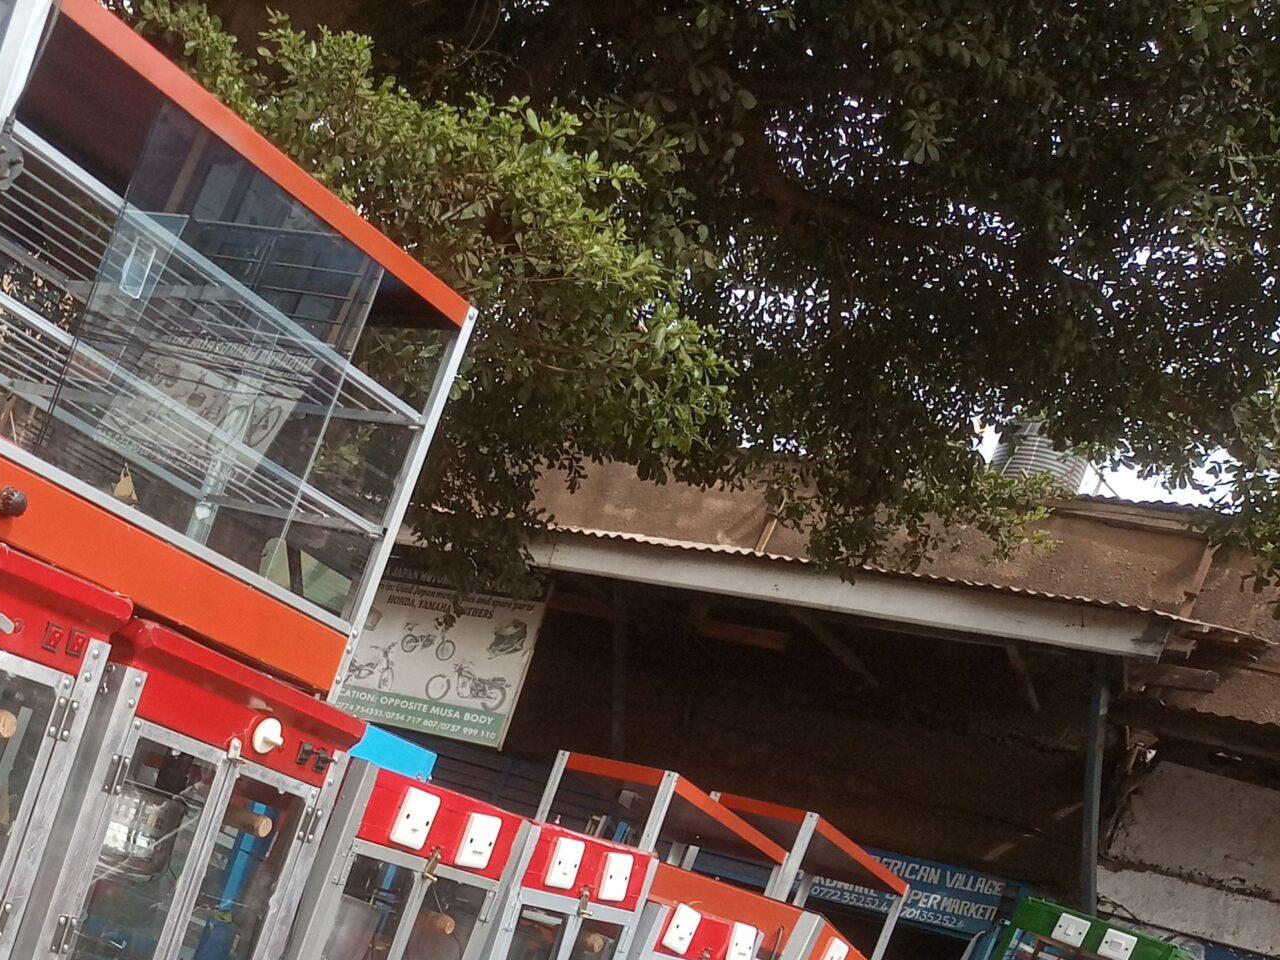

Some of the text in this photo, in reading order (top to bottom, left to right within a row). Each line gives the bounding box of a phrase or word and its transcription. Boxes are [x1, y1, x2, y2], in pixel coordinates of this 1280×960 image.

[466, 606, 495, 620] THERS
[338, 688, 495, 726] CATION: OPPOSITE MUSA BODY
[946, 870, 1007, 897] VILLAGE
